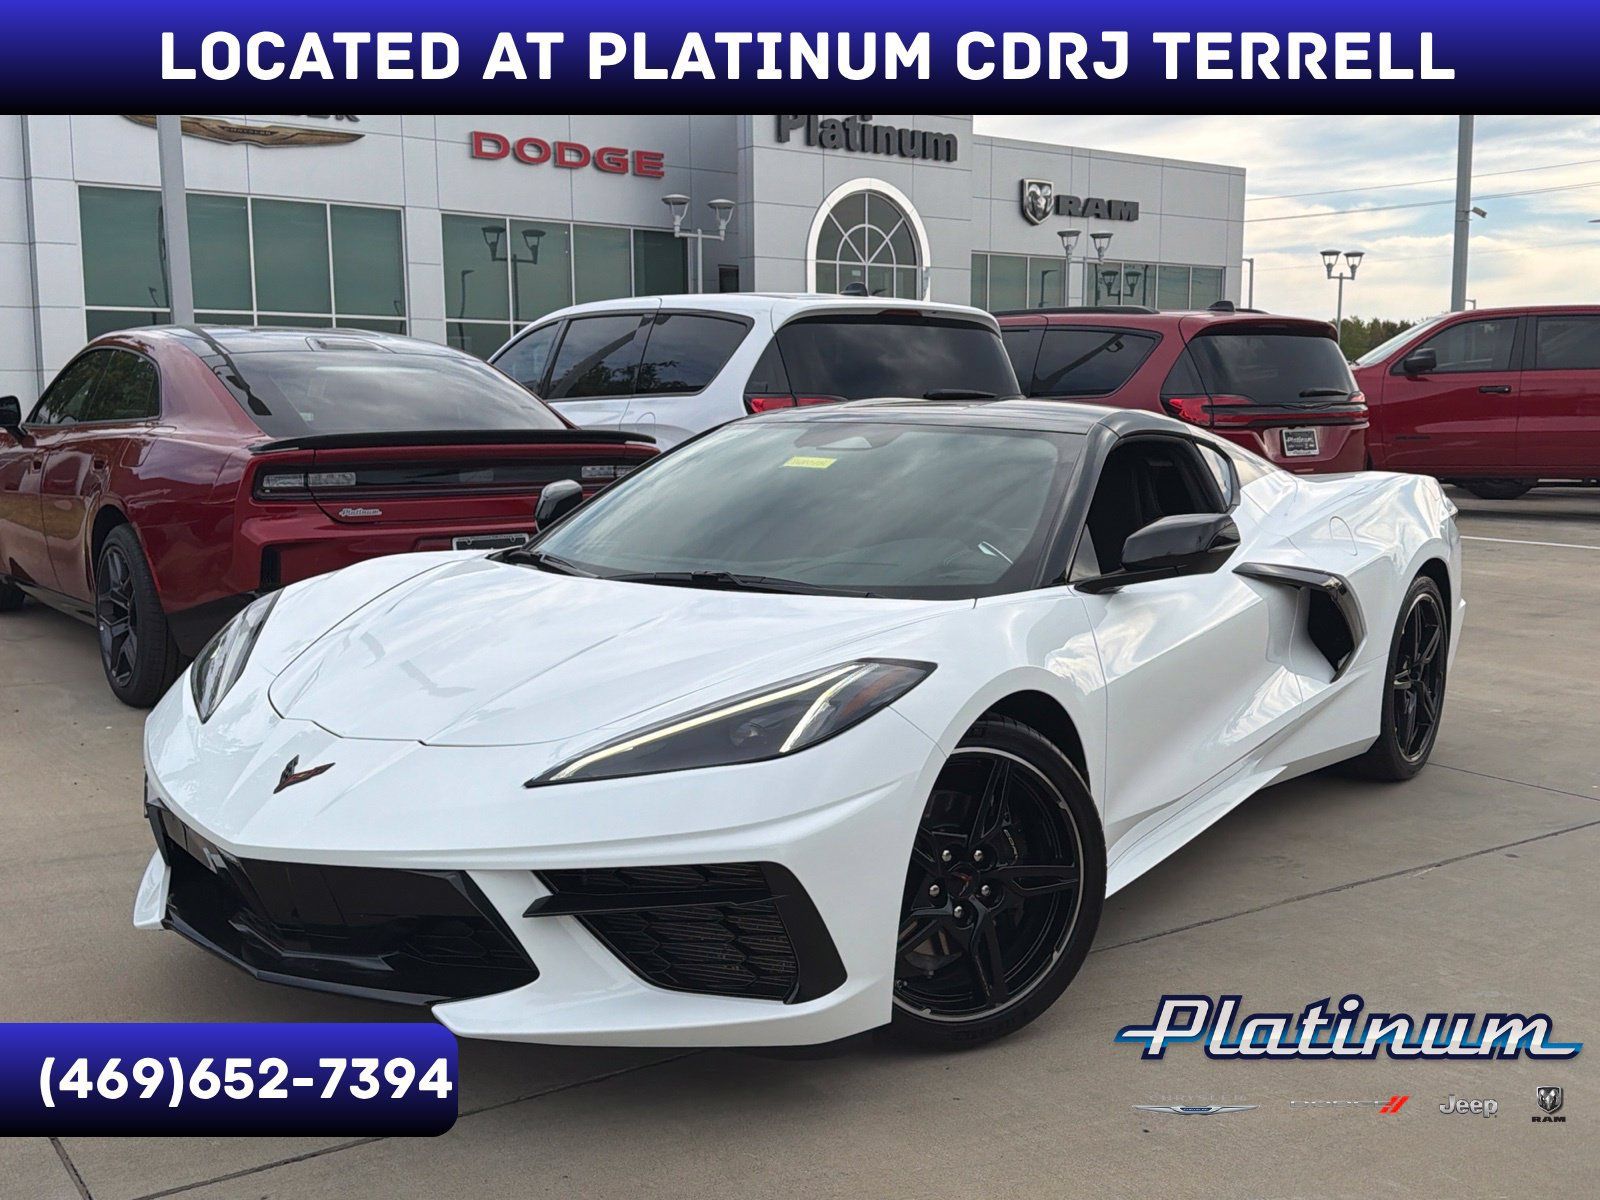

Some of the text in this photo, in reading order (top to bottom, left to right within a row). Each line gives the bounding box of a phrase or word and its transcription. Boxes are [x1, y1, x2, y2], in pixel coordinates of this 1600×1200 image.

[471, 131, 666, 179] DODGE
[776, 115, 959, 163] Platinum
[1054, 194, 1140, 222] RAM
